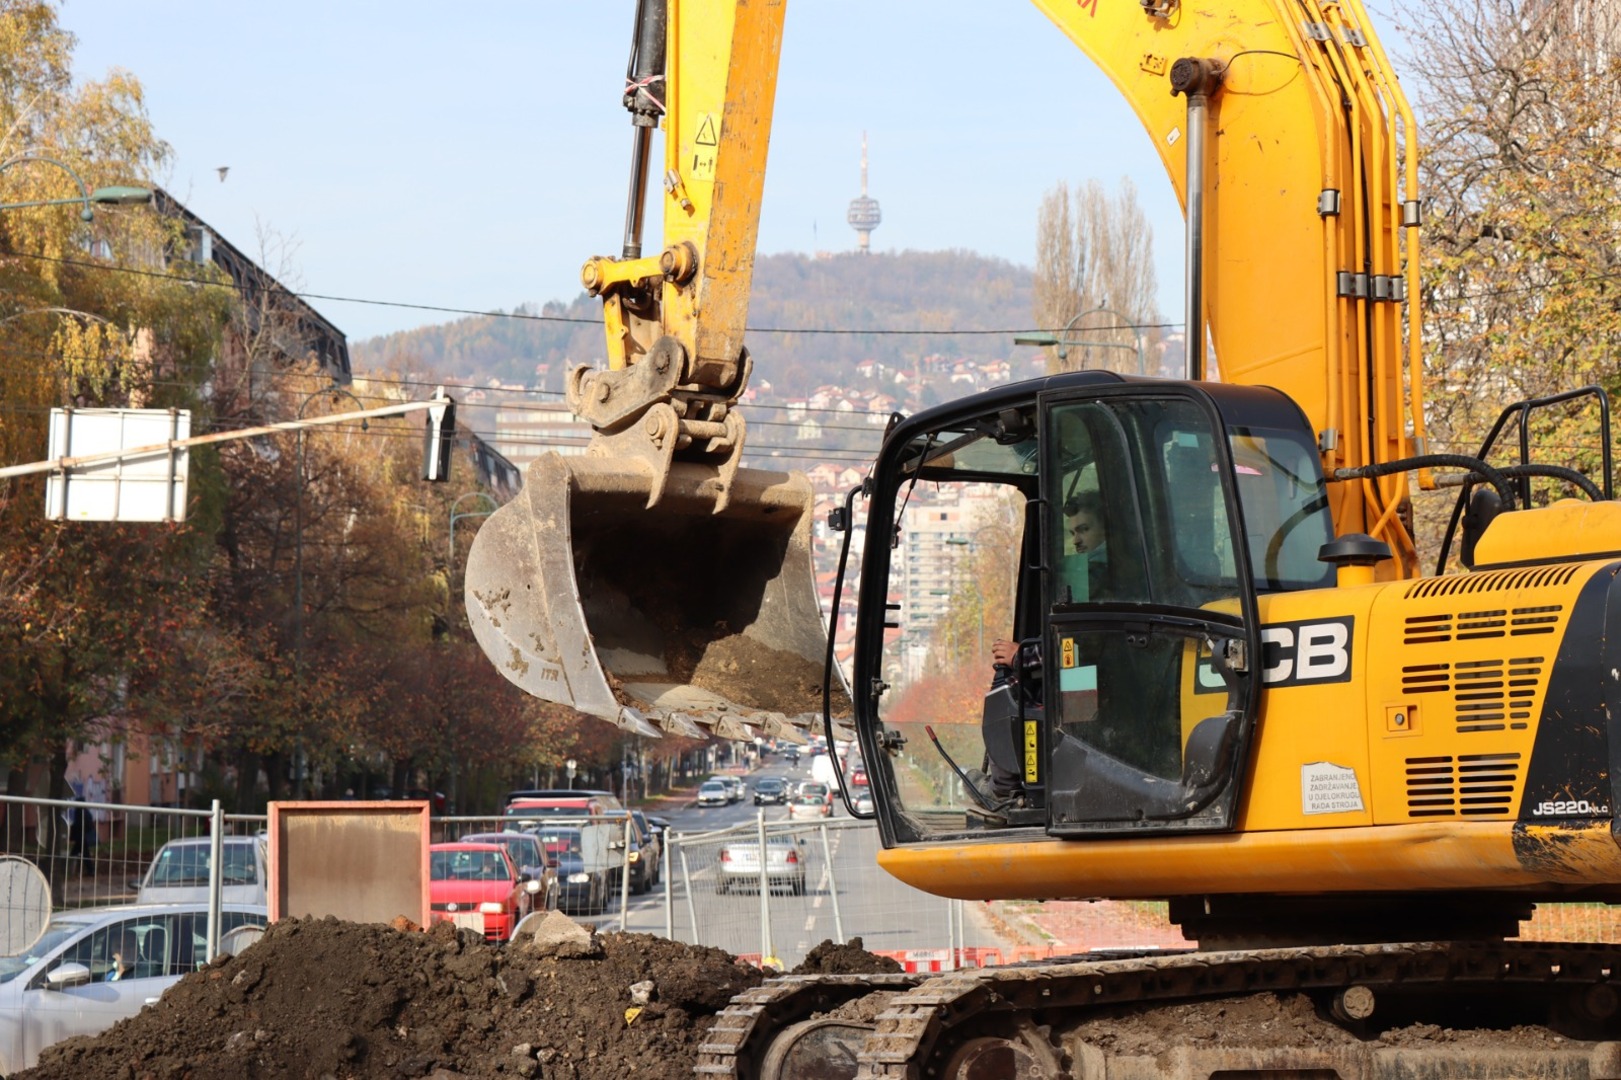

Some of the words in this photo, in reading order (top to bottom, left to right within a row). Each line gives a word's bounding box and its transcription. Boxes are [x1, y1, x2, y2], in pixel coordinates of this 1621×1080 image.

[540, 667, 559, 681] ITR
[1310, 782, 1357, 791] ZADRŽAVANJE
[1308, 793, 1314, 801] U
[1311, 802, 1330, 810] RADA
[1331, 800, 1358, 809] STROJA
